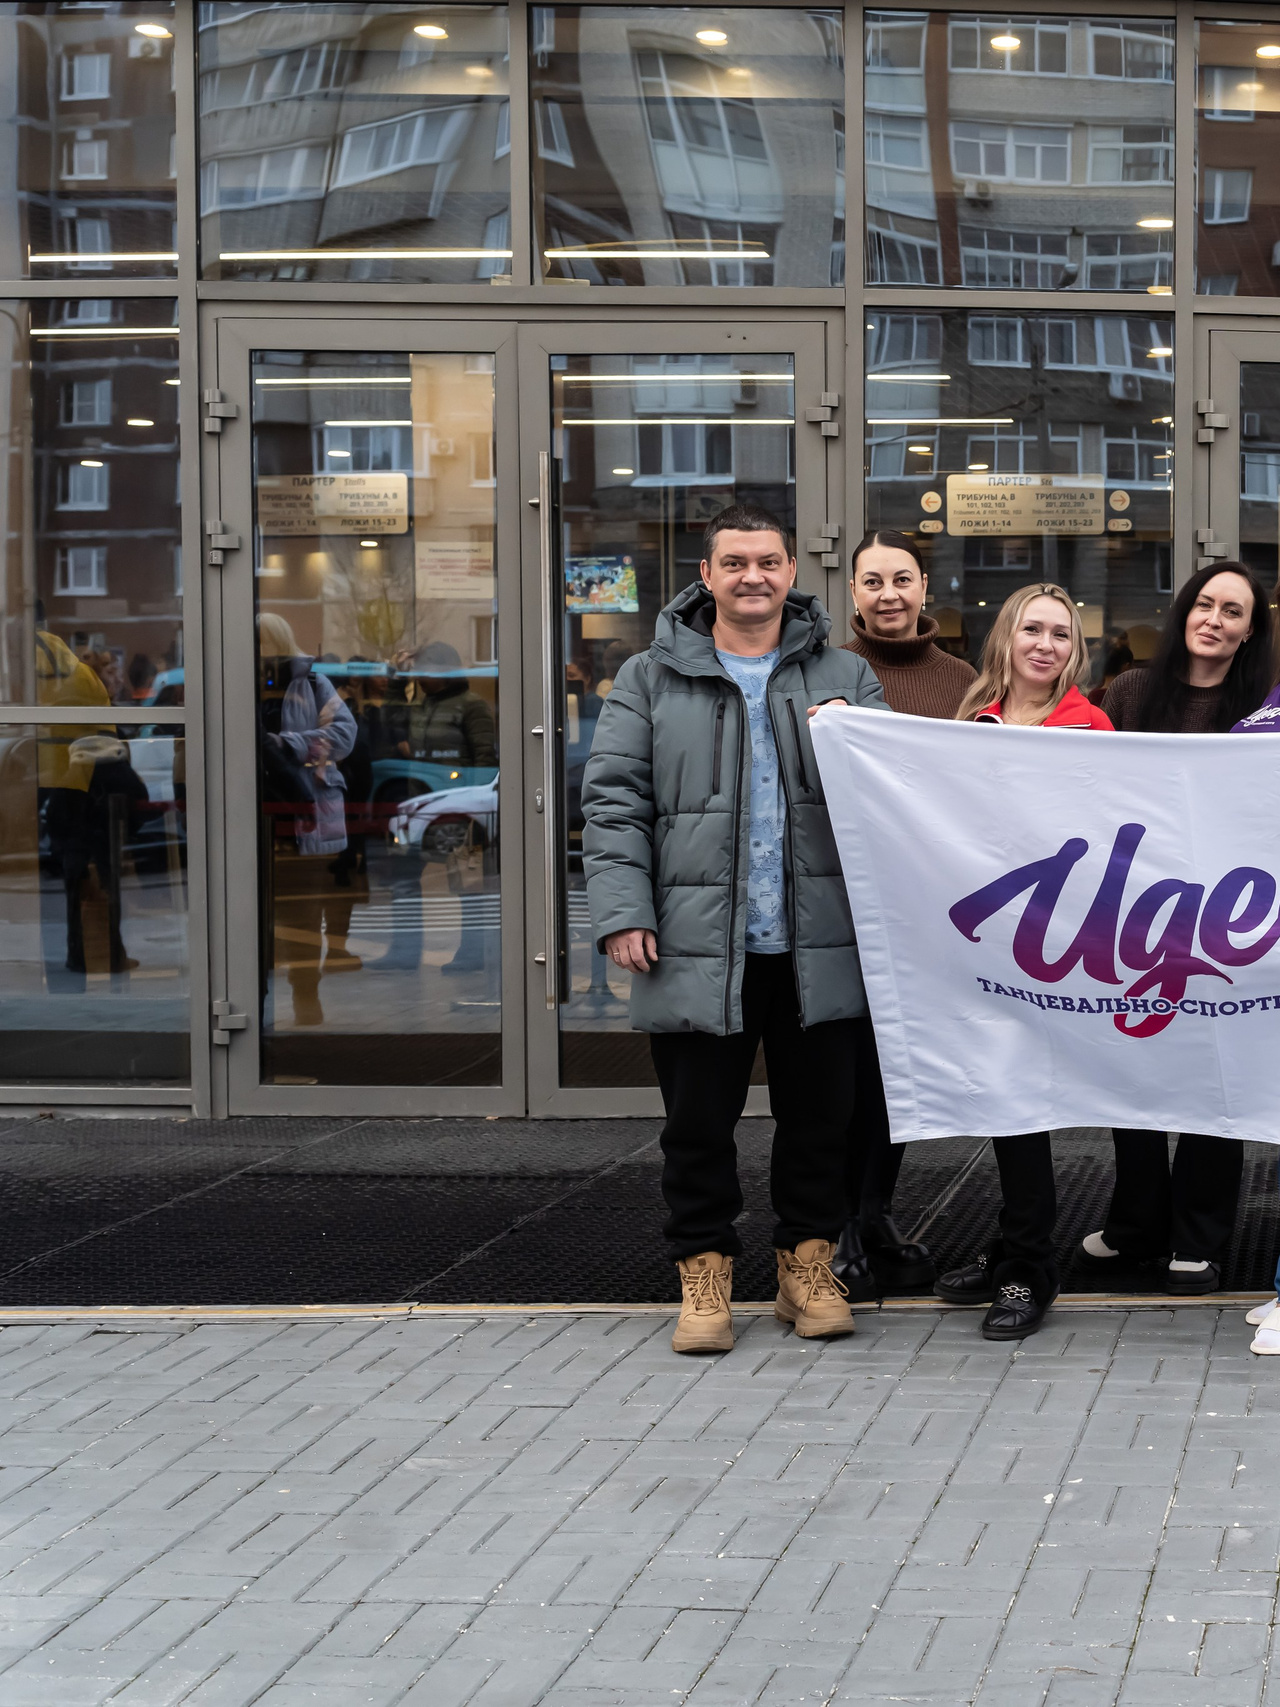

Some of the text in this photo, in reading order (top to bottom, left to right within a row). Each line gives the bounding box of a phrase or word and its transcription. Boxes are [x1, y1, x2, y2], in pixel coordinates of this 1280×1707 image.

[292, 477, 336, 487] ПАРТЕР
[988, 476, 1032, 487] ПАРТЕР
[338, 492, 380, 500] ТРИБУНЫ
[956, 493, 998, 501] ТРИБУНЫ
[1034, 492, 1077, 500] ТРИБУНЫ
[340, 518, 369, 527] ЛОЖИ
[959, 519, 989, 527] ЛОЖИ
[1036, 518, 1066, 527] ЛОЖИ
